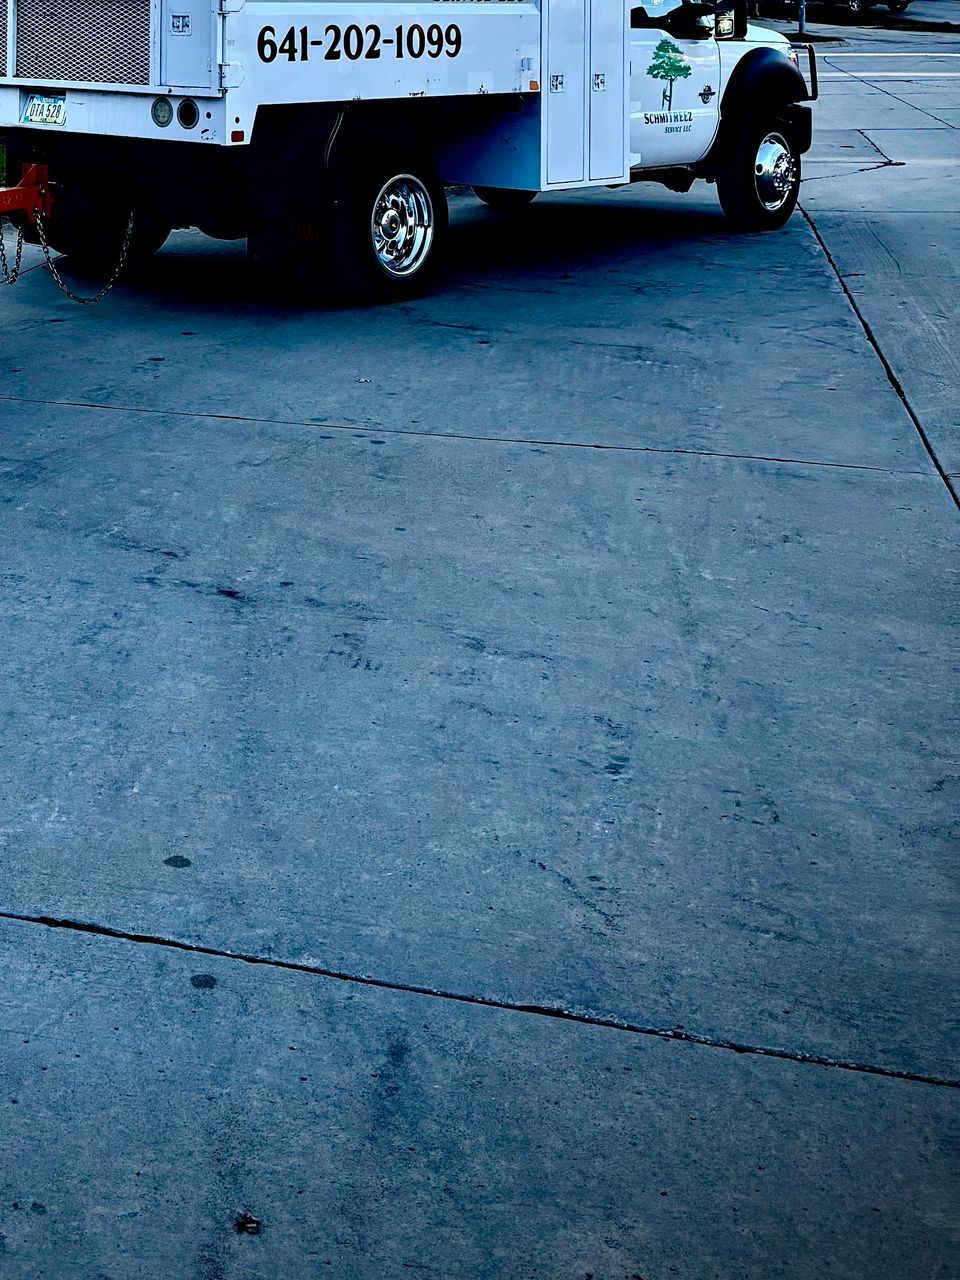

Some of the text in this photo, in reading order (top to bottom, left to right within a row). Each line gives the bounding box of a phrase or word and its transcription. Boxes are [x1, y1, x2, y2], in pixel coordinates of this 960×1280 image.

[256, 23, 463, 64] 641-202-1099
[46, 104, 61, 118] 528
[644, 111, 693, 124] SCHMITREEZ
